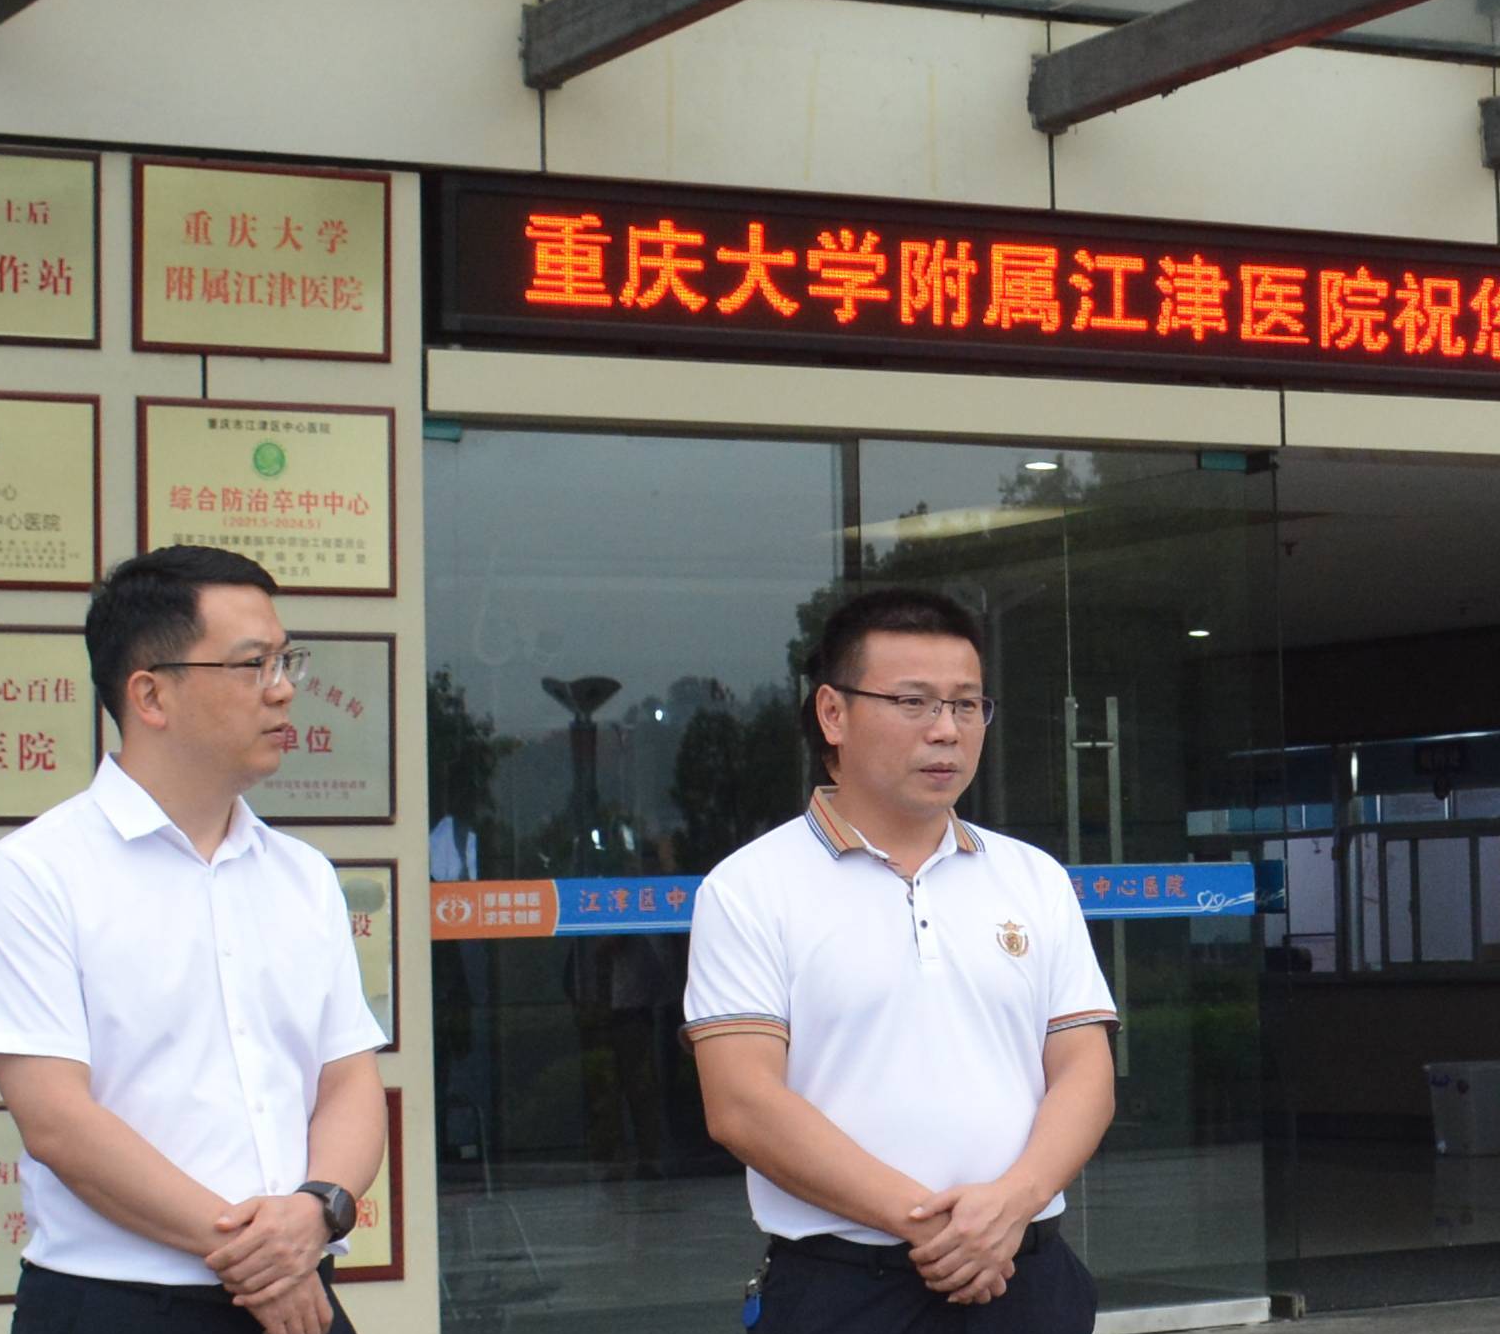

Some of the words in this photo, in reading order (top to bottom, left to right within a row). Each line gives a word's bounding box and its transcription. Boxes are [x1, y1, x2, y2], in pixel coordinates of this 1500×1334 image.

[183, 210, 349, 255] 重庆大学
[164, 265, 364, 312] 附属江津医院
[207, 417, 331, 434] 重庆市江津区中心医院
[170, 485, 370, 516] 综合防治卒中中心
